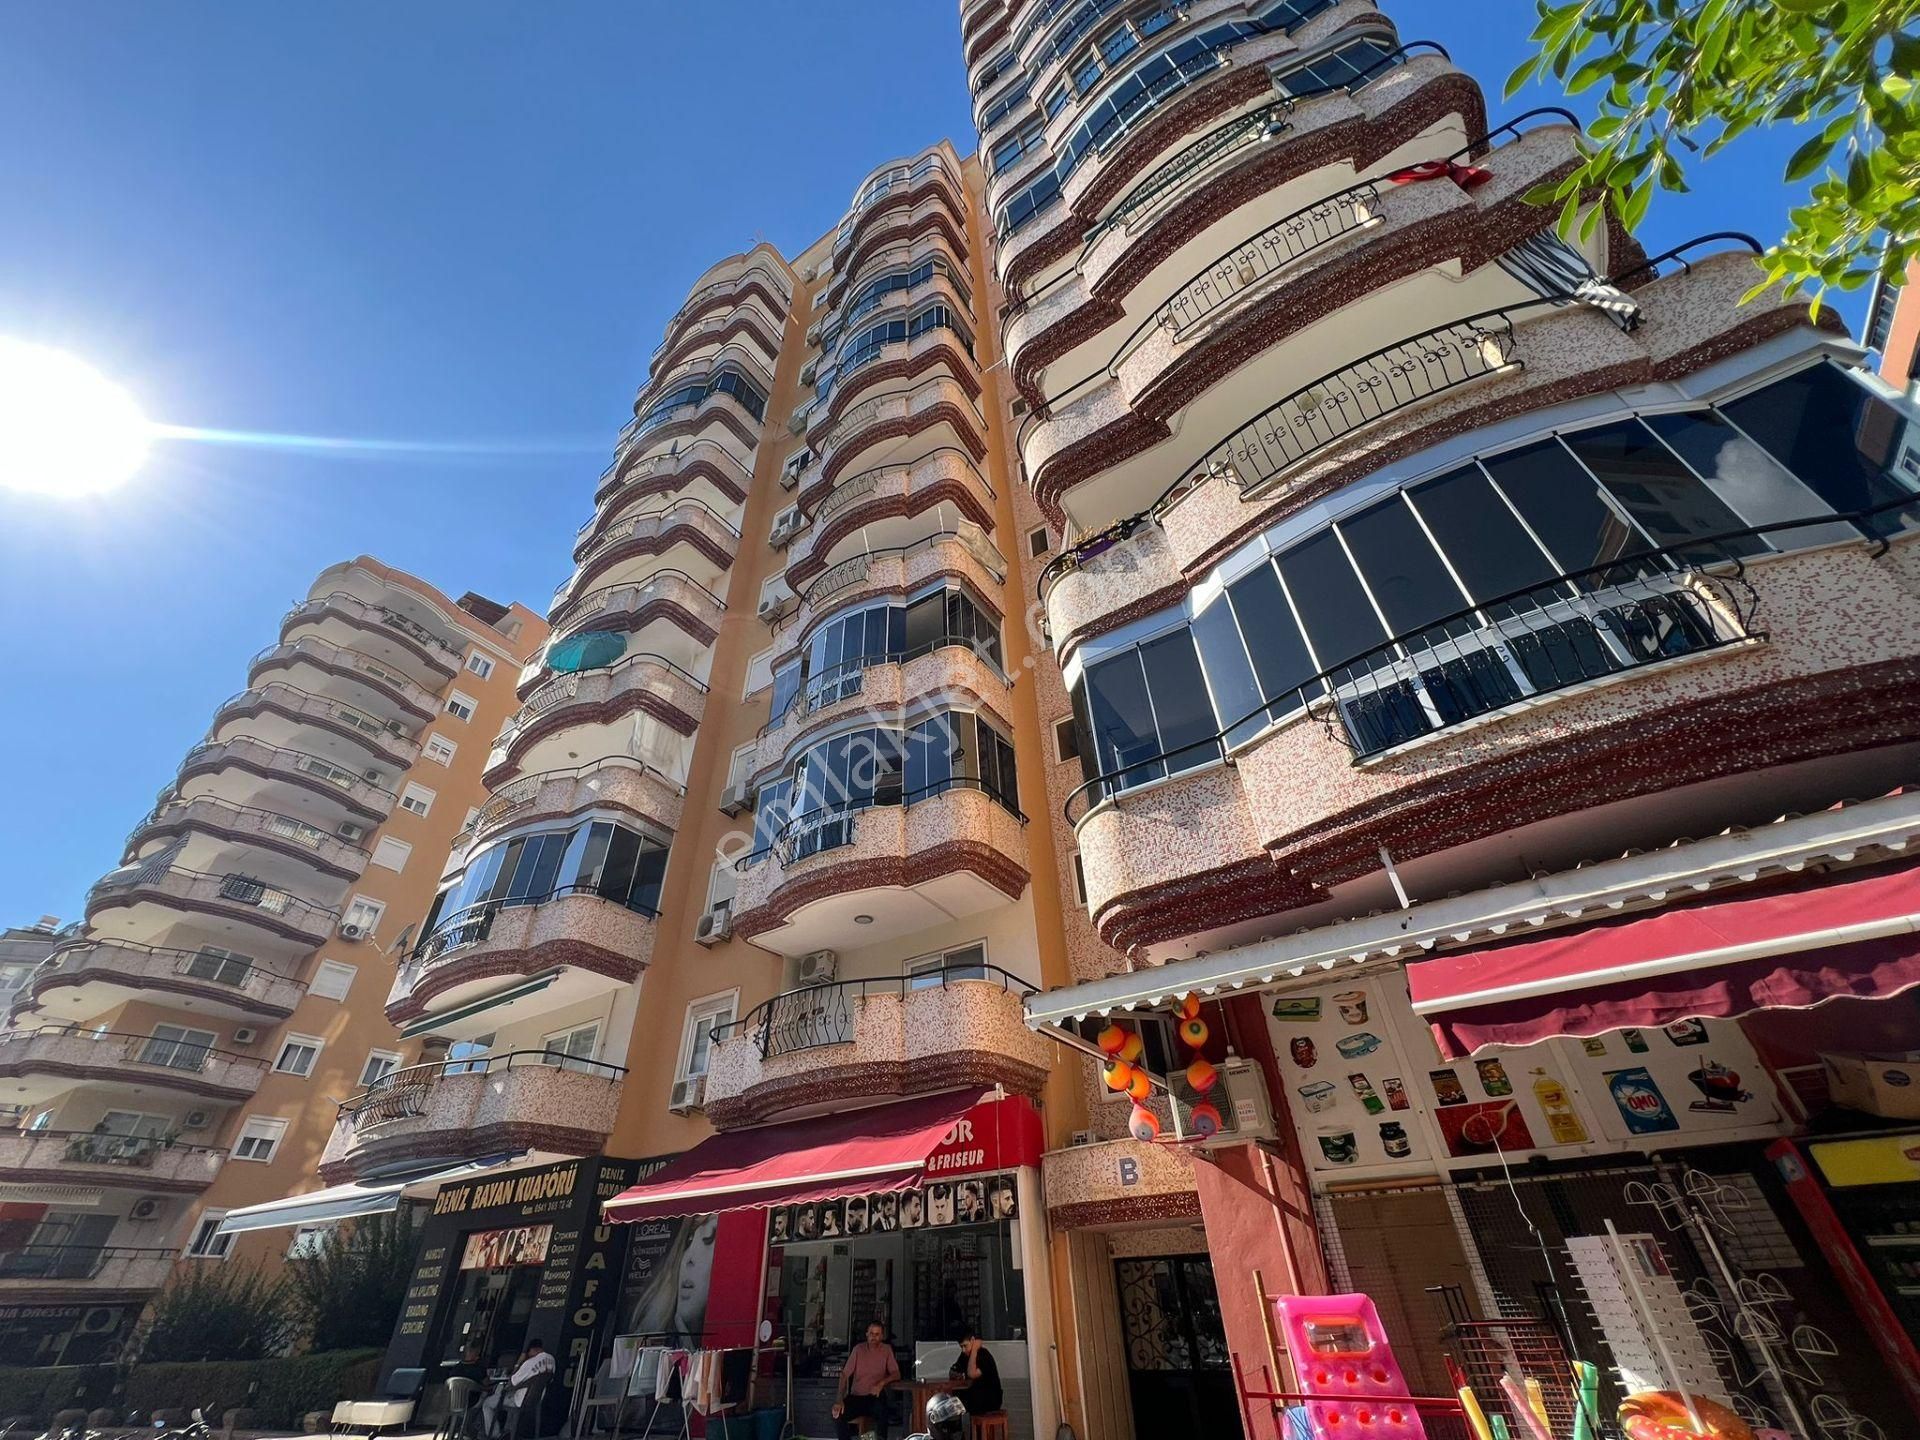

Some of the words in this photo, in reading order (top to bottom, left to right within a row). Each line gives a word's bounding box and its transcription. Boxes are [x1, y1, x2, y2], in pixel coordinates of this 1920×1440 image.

[1627, 1094, 1658, 1111] OMO
[471, 1179, 515, 1210] BAYAN
[514, 1163, 578, 1203] KUAFÖRÜ
[1119, 1157, 1139, 1187] B
